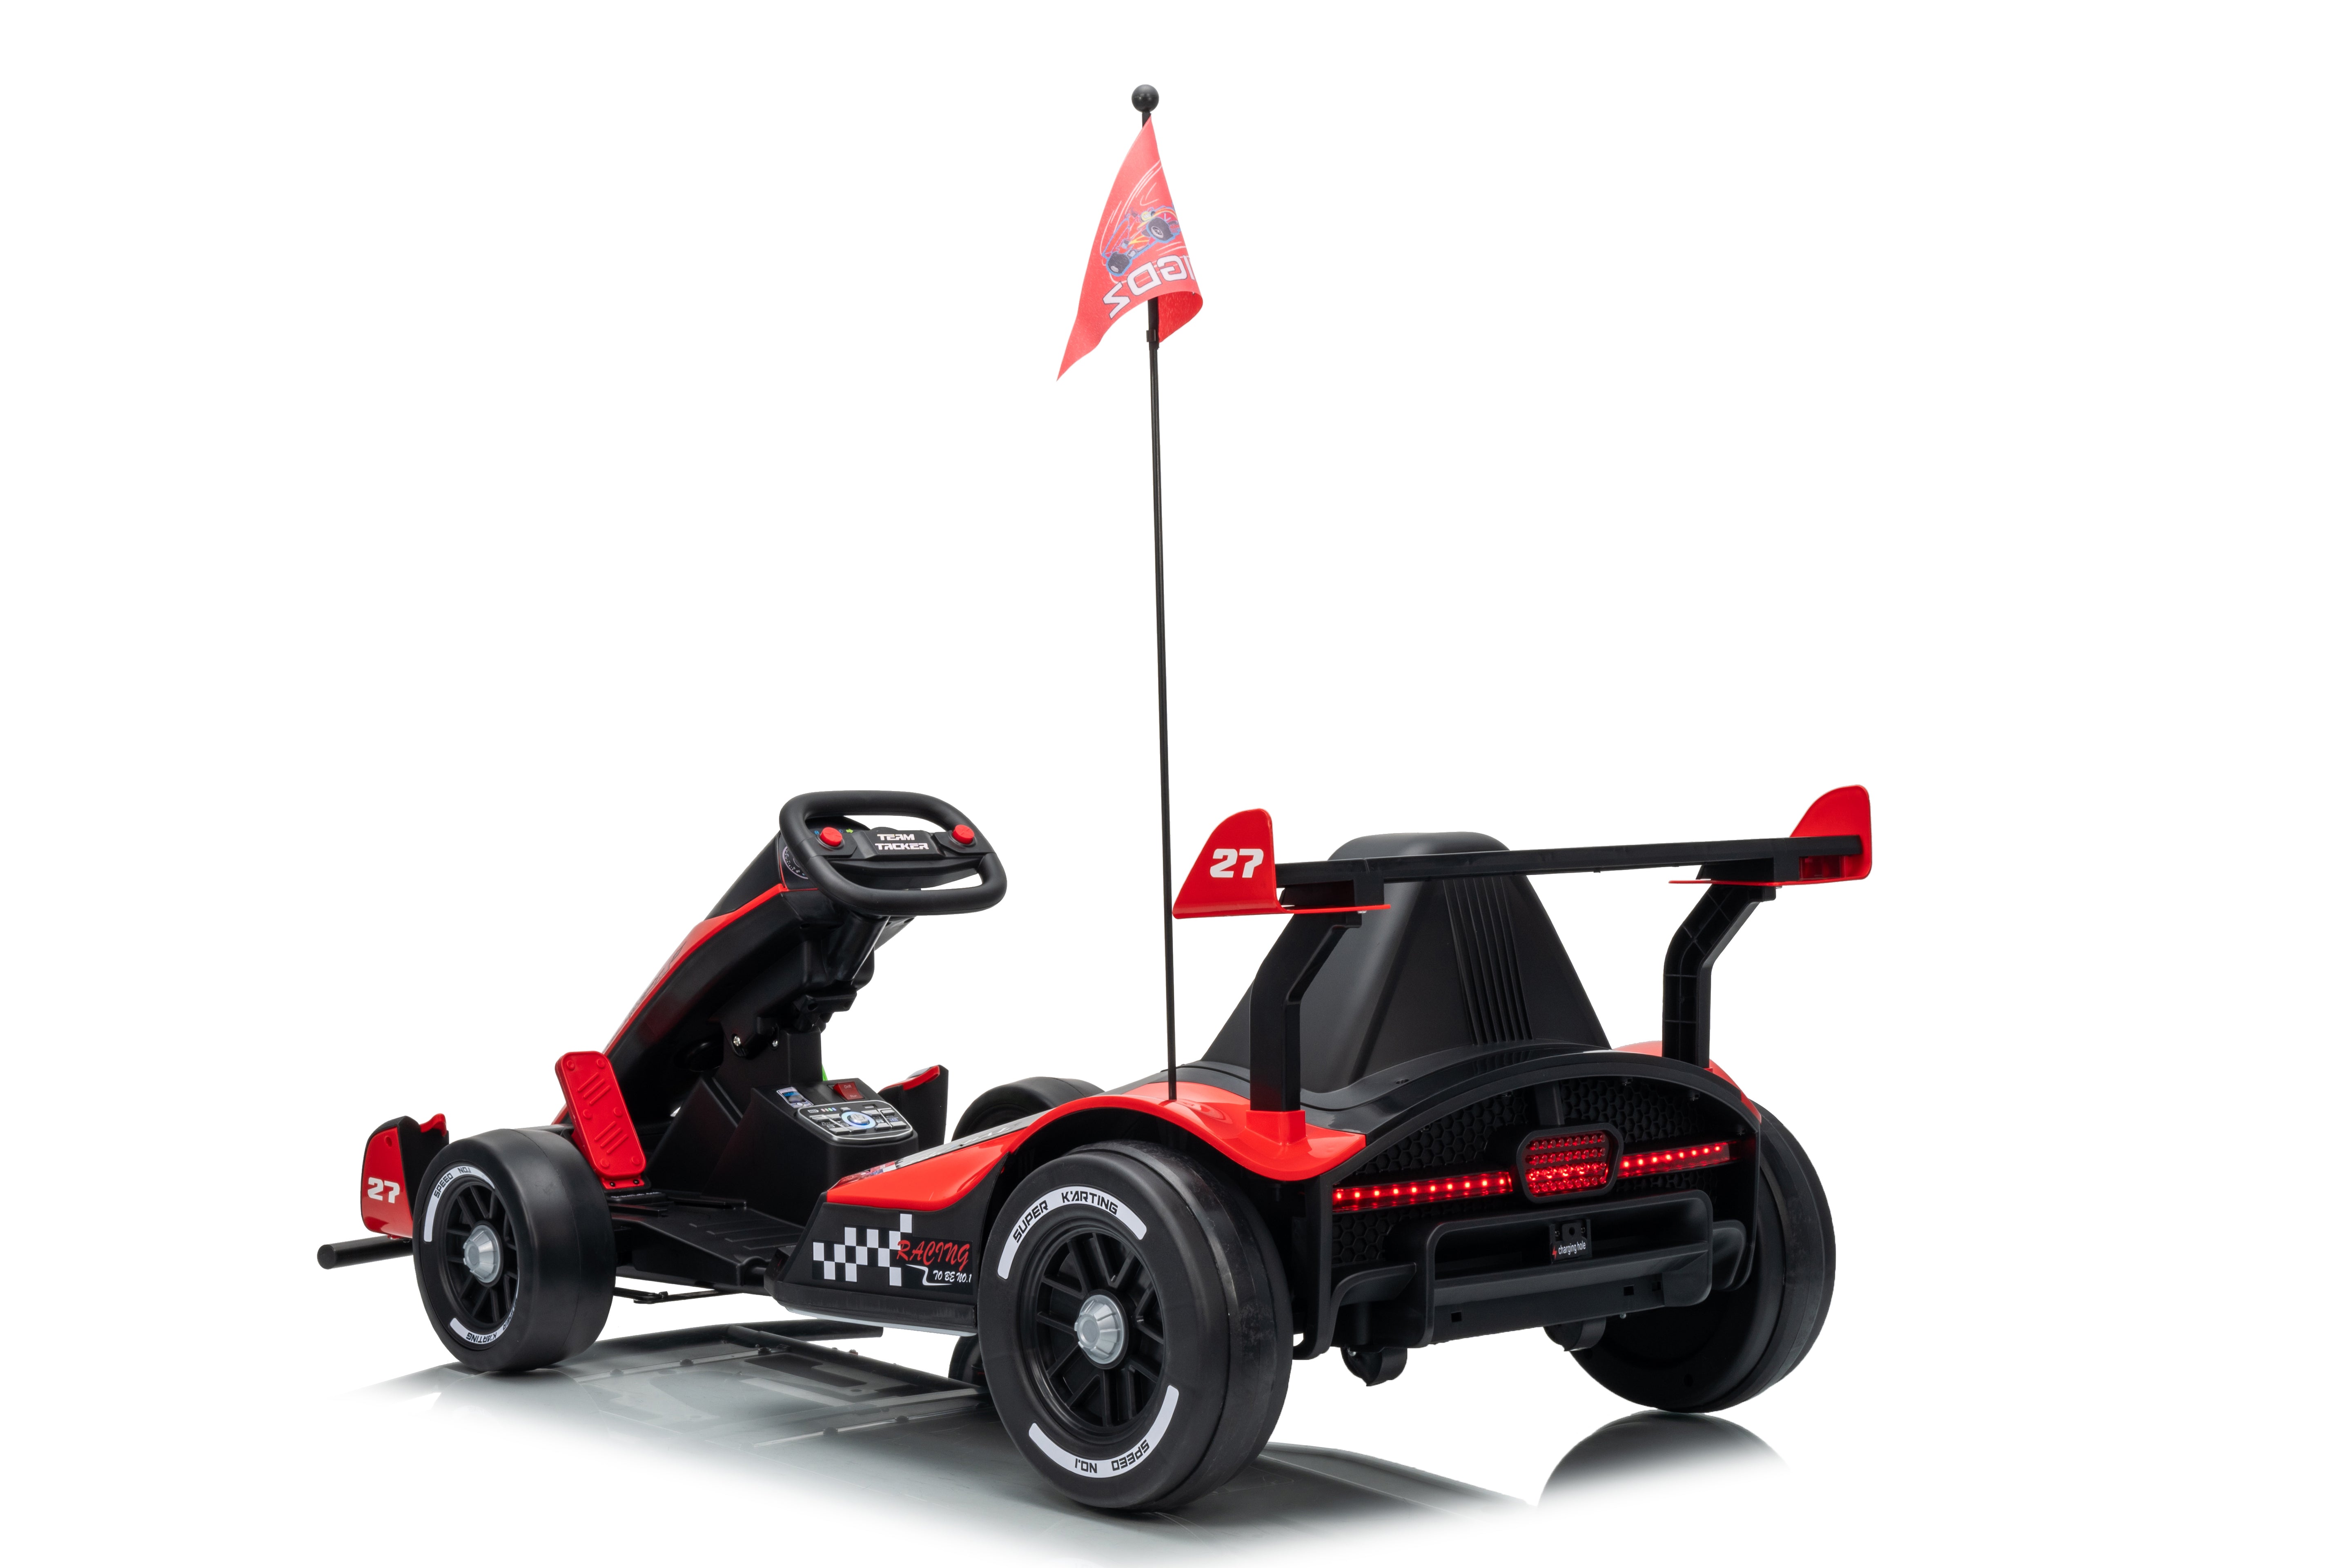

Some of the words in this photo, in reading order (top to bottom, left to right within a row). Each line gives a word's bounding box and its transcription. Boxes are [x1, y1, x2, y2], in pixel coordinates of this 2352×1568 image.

[1209, 848, 1264, 878] 27
[368, 1177, 400, 1204] 27
[434, 1172, 454, 1198] SPEED
[1013, 1200, 1048, 1243] SUPER
[896, 1240, 970, 1272] RACING
[1558, 1243, 1577, 1256] charging
[1577, 1240, 1586, 1251] hole
[933, 1270, 943, 1281] TO
[944, 1271, 956, 1282] BE
[956, 1272, 972, 1283] NO.1
[1075, 1458, 1098, 1474] NO.1
[1111, 1439, 1150, 1472] SPEED
